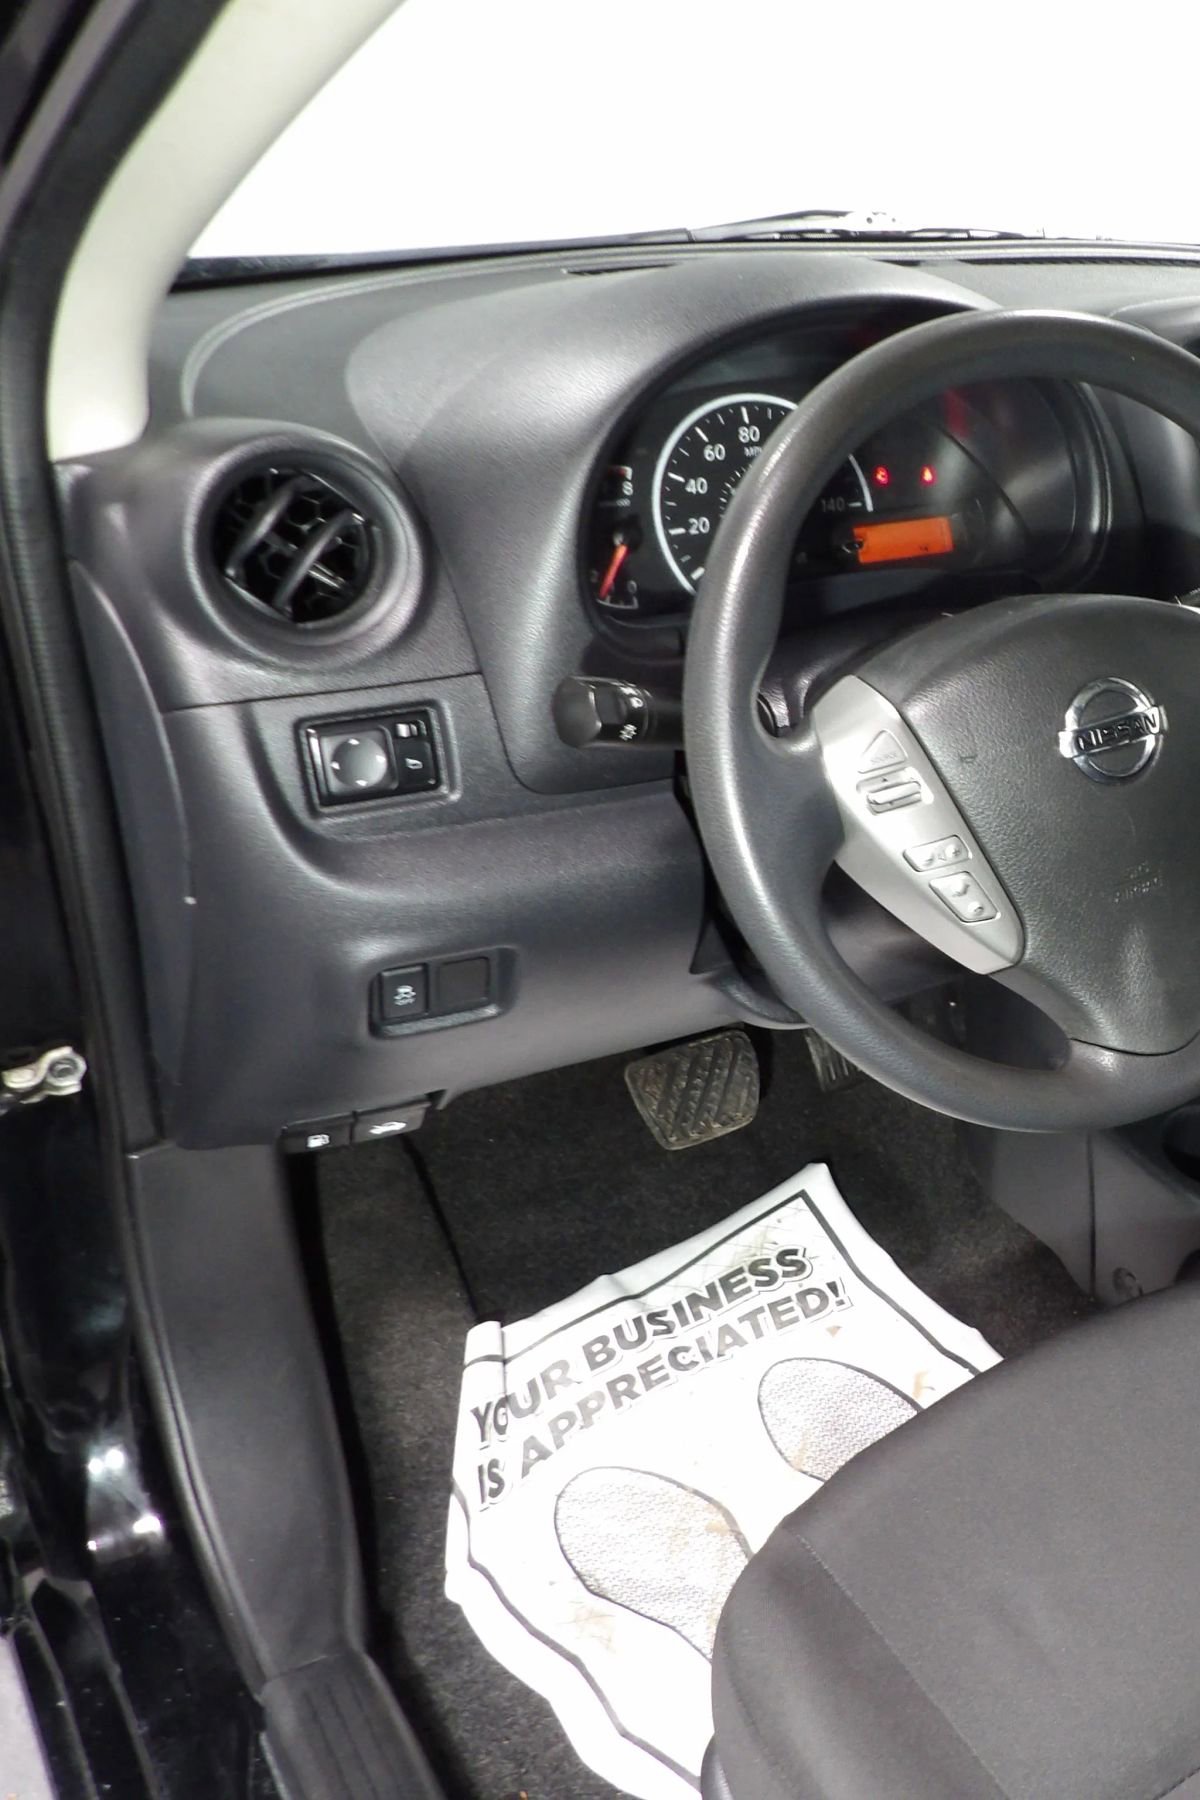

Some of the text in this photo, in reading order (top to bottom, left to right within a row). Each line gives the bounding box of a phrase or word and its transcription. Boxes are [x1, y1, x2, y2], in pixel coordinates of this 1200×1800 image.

[738, 425, 760, 443] 80
[703, 443, 725, 462] 60
[685, 477, 708, 494] 40
[822, 497, 845, 512] 140
[688, 516, 710, 535] 20
[1077, 709, 1158, 752] NISSAN
[471, 1248, 807, 1443] YOUR BUSINESS
[477, 1281, 846, 1505] IS APPRECIATED!
